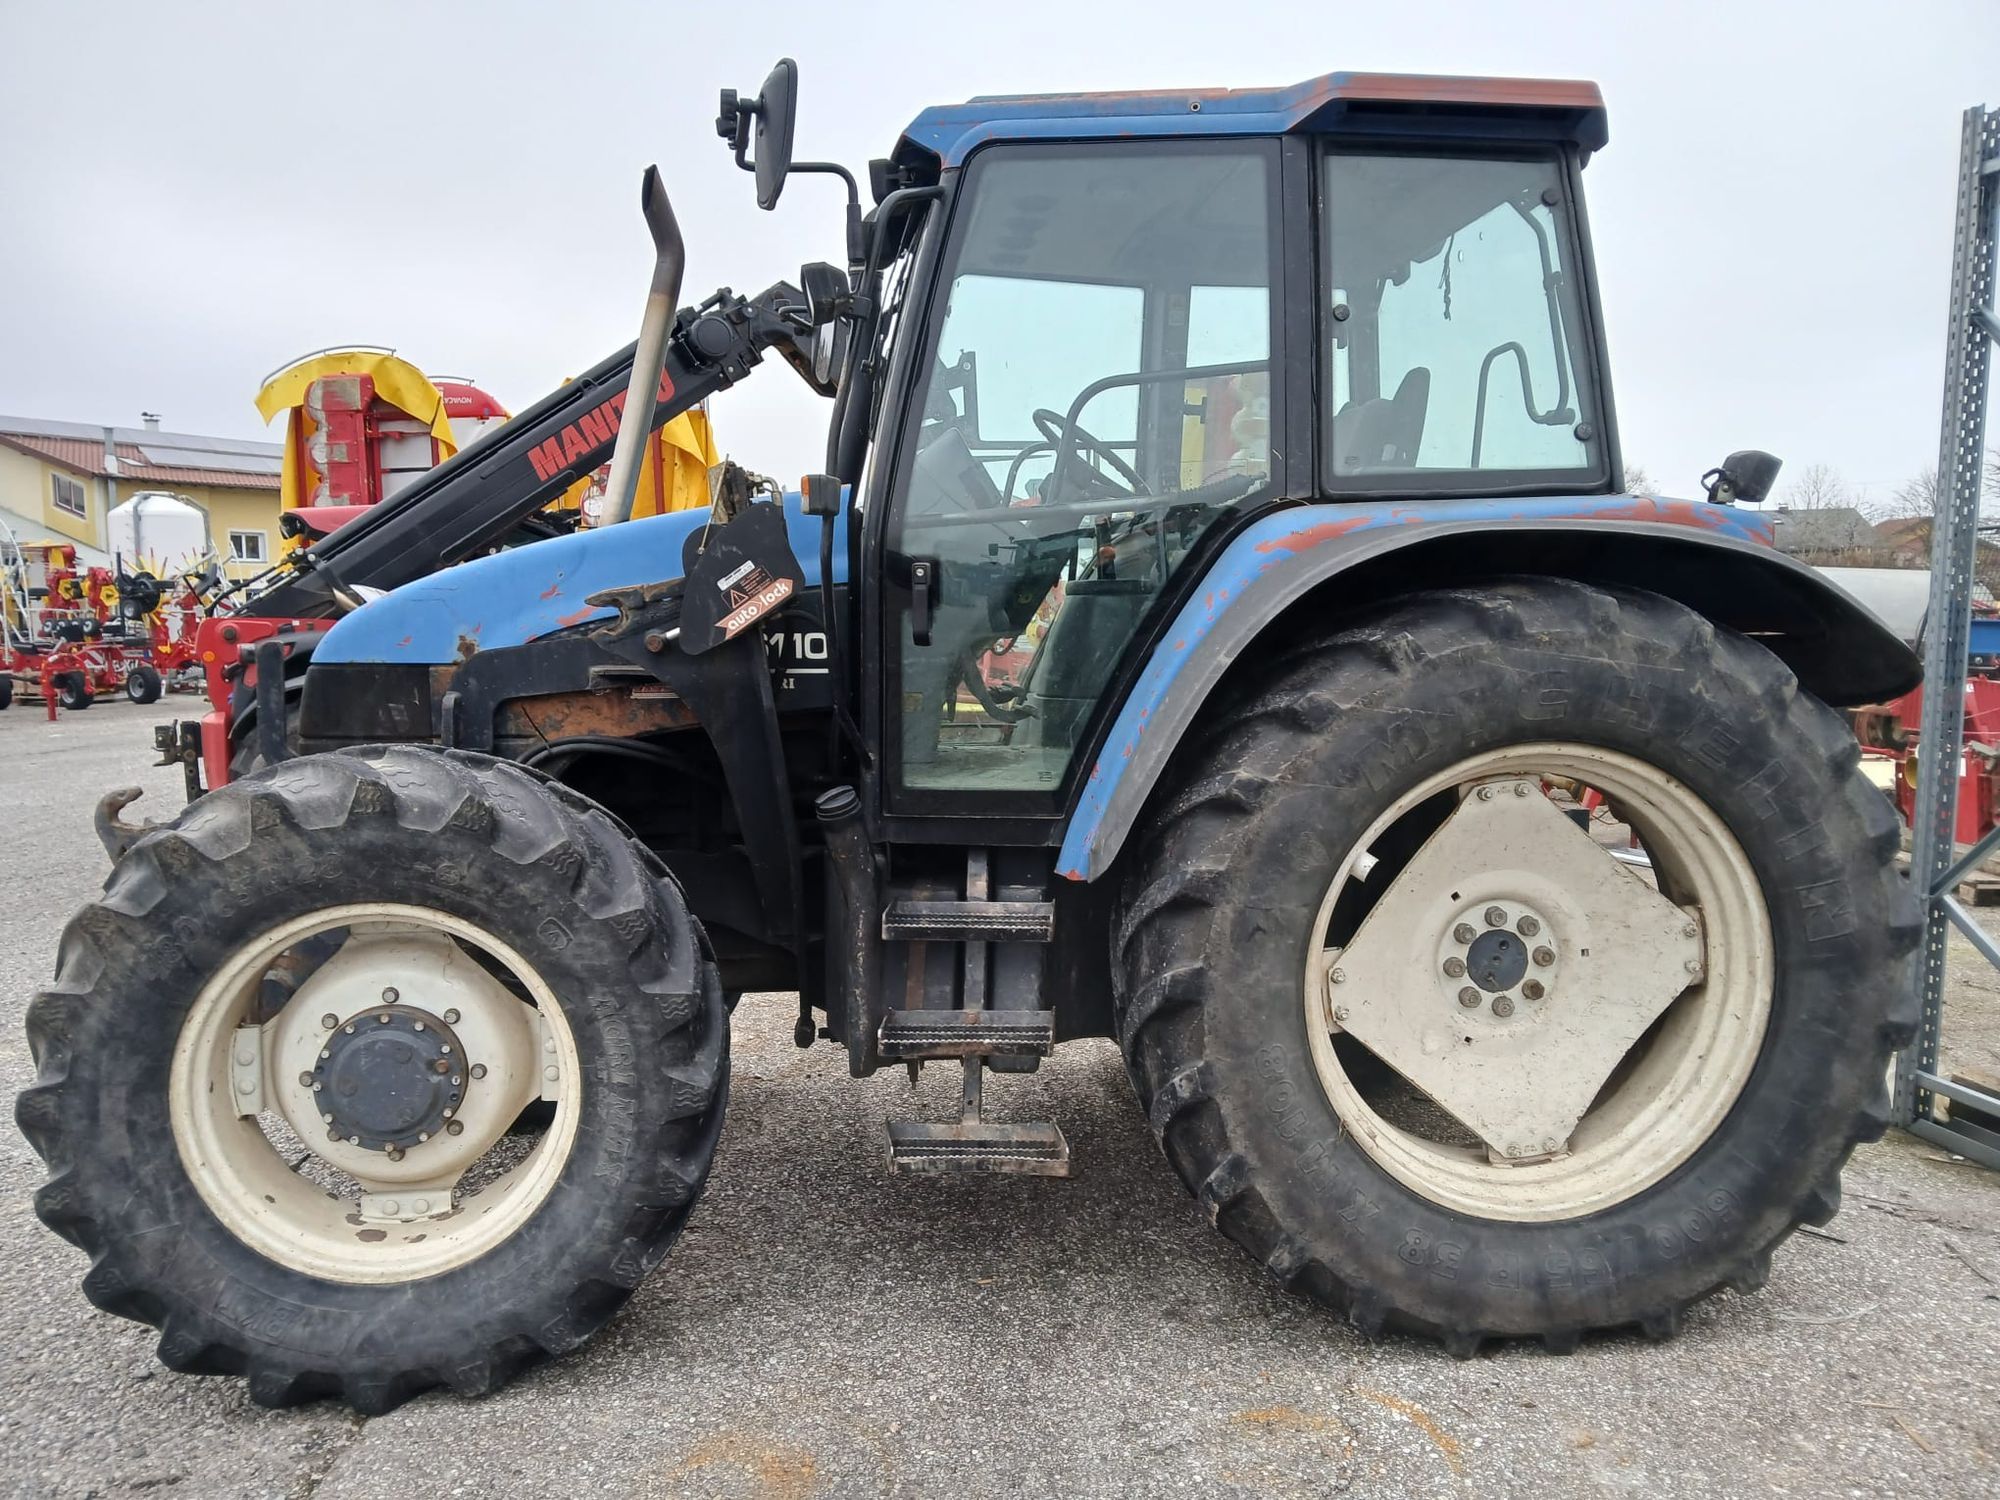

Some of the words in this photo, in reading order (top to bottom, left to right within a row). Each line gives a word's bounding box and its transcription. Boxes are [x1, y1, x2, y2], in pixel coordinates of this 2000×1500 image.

[527, 366, 676, 481] MANIU
[728, 606, 758, 630] auto
[759, 583, 789, 606] lock
[1357, 670, 1859, 943] MICHELIN
